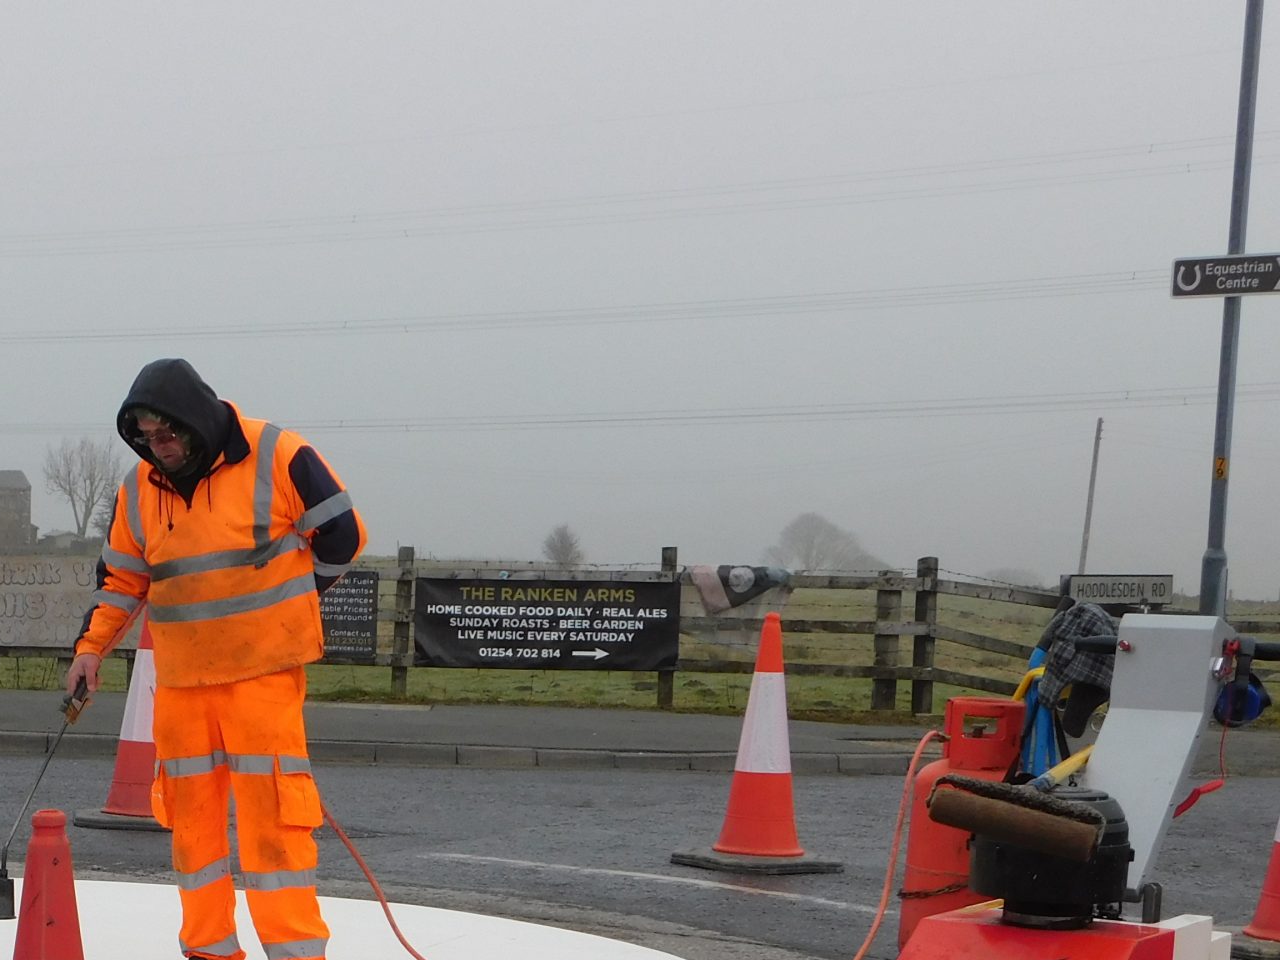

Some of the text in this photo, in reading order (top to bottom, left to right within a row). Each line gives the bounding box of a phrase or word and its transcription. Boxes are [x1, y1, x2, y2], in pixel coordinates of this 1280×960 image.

[1205, 261, 1273, 276] Equestrian
[1216, 277, 1259, 289] Centre
[460, 588, 635, 602] THE RANKEN ARMS
[1077, 582, 1165, 598] HODDLESDEN RD
[427, 605, 667, 618] HOME COOKED FOOD DAILY REAL ALES
[449, 618, 644, 630] SUNDAY ROASTS BEER GARDEN
[458, 630, 635, 642] LIVE MUSIC EVERY SATURDAY
[479, 647, 561, 658] 01254 702 814
